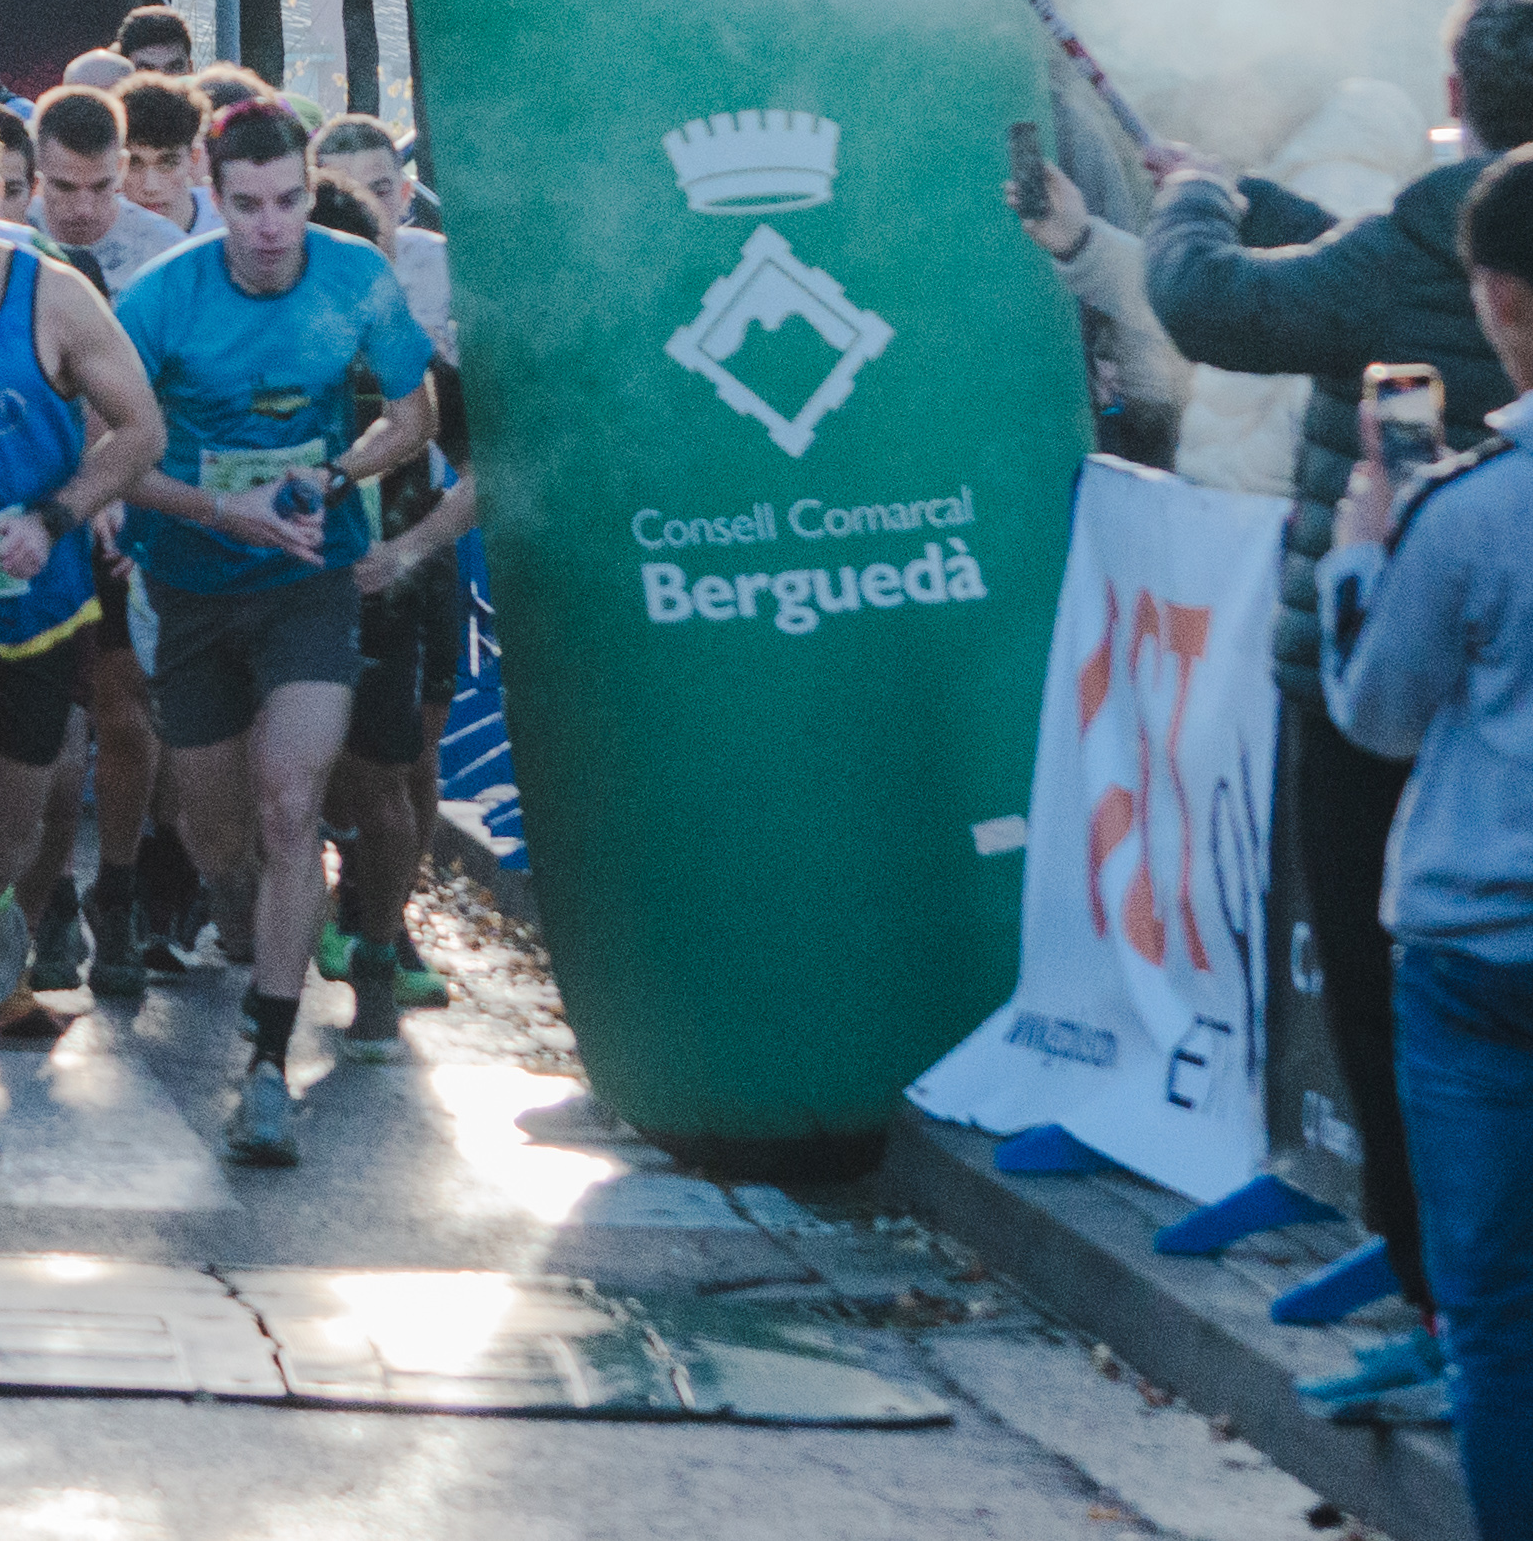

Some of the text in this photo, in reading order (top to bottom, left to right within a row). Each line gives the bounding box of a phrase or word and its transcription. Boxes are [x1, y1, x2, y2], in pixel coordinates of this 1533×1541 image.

[631, 483, 975, 551] Consell Comarcal
[640, 537, 988, 635] Berguedà
